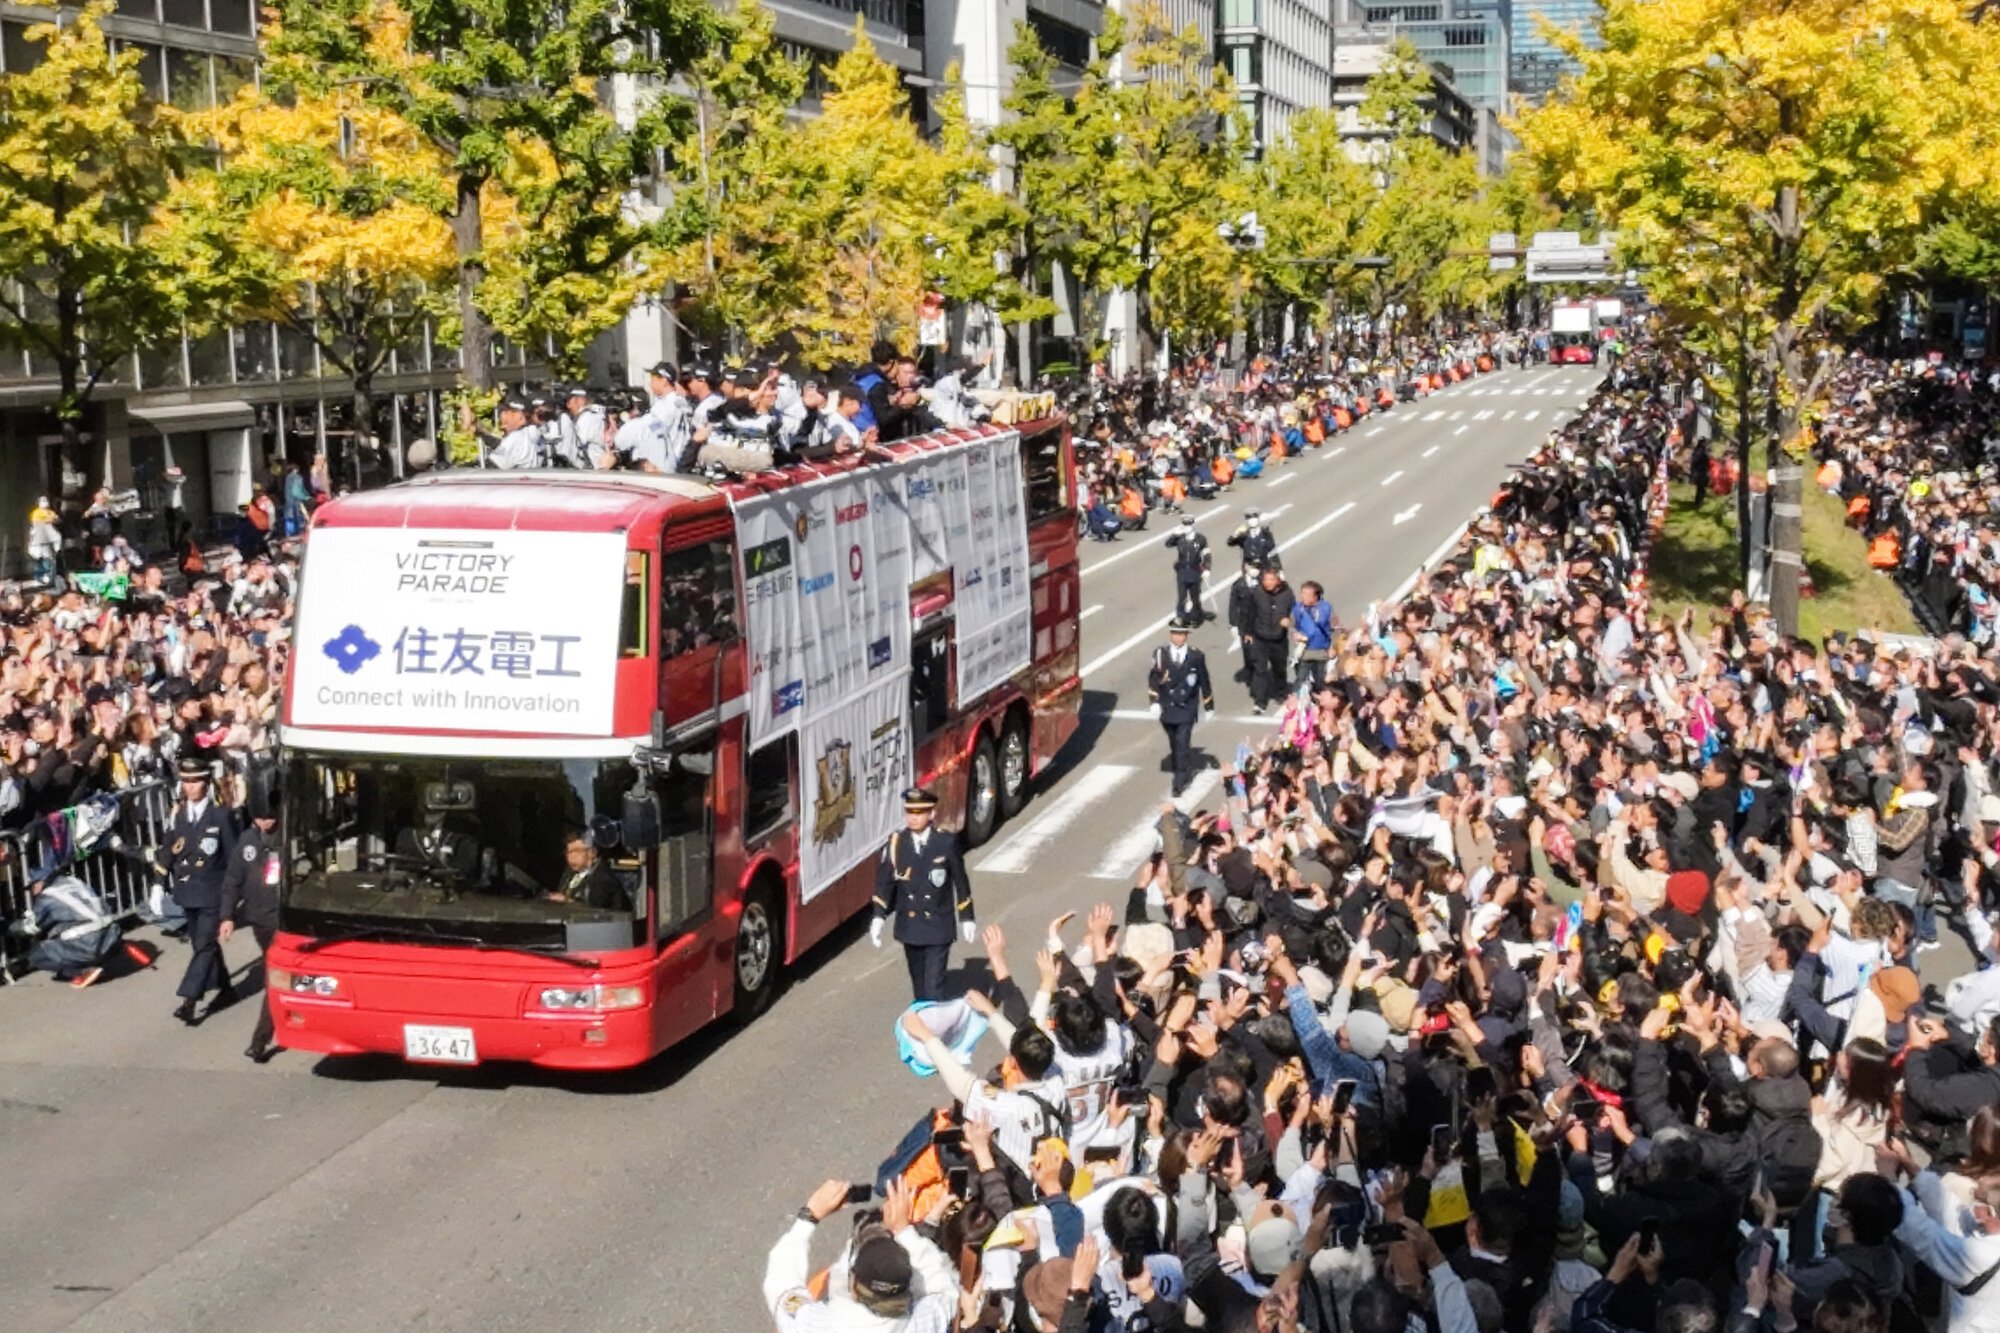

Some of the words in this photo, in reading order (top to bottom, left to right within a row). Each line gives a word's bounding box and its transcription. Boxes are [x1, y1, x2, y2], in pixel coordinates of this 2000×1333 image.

[396, 553, 514, 571] VICTORY
[397, 574, 509, 593] PARADE
[392, 626, 582, 679] 住友電工
[317, 685, 403, 706] Connect
[412, 689, 456, 708] with
[464, 690, 580, 713] Innovation
